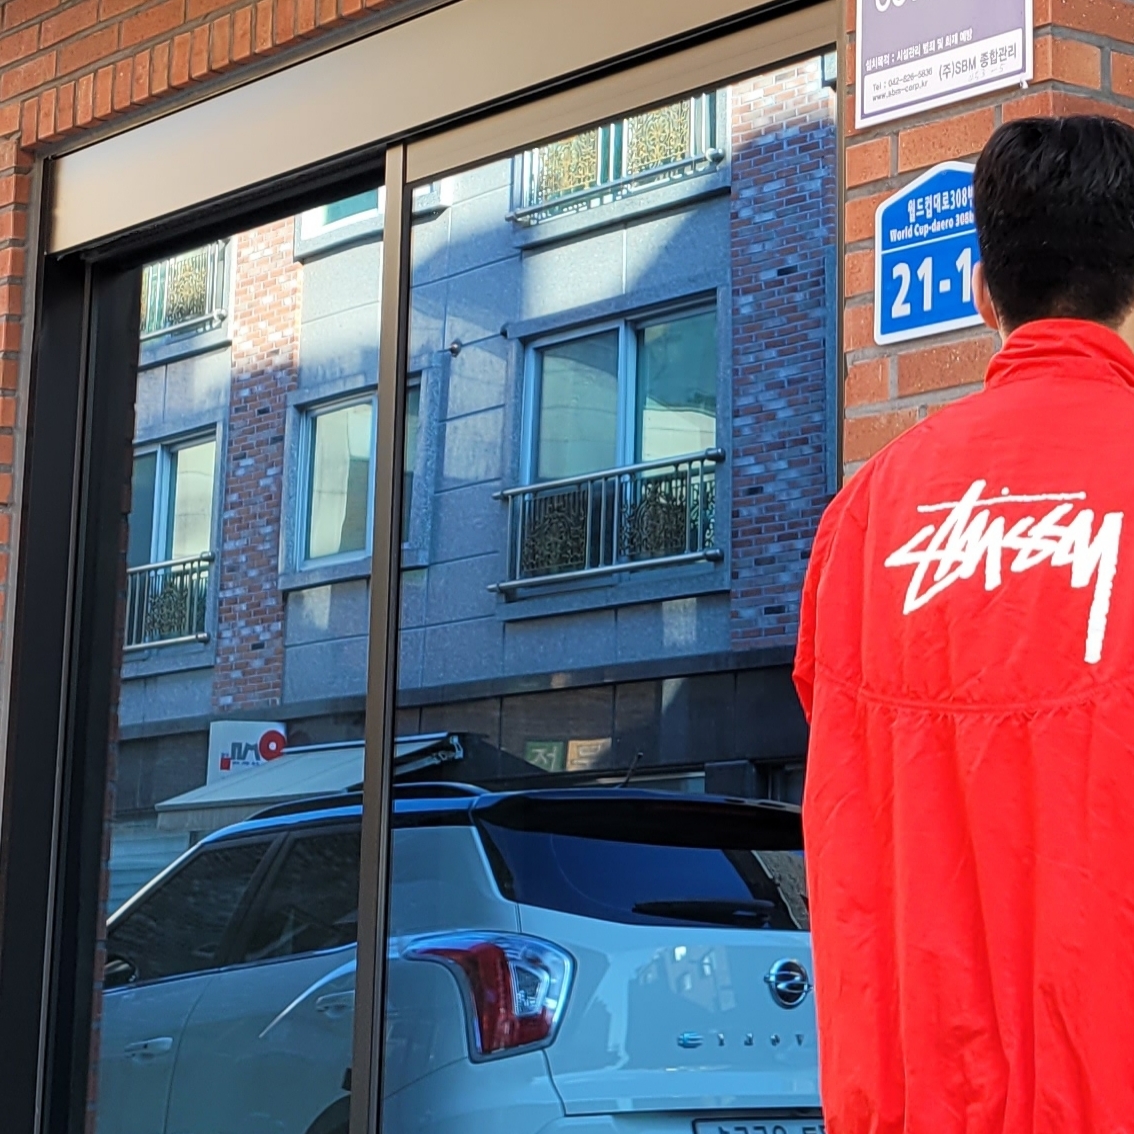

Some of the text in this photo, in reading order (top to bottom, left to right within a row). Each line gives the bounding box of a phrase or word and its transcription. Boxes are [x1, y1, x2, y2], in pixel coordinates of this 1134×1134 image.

[896, 43, 921, 62] 시설관리
[889, 209, 975, 243] World Cup-daero 308b
